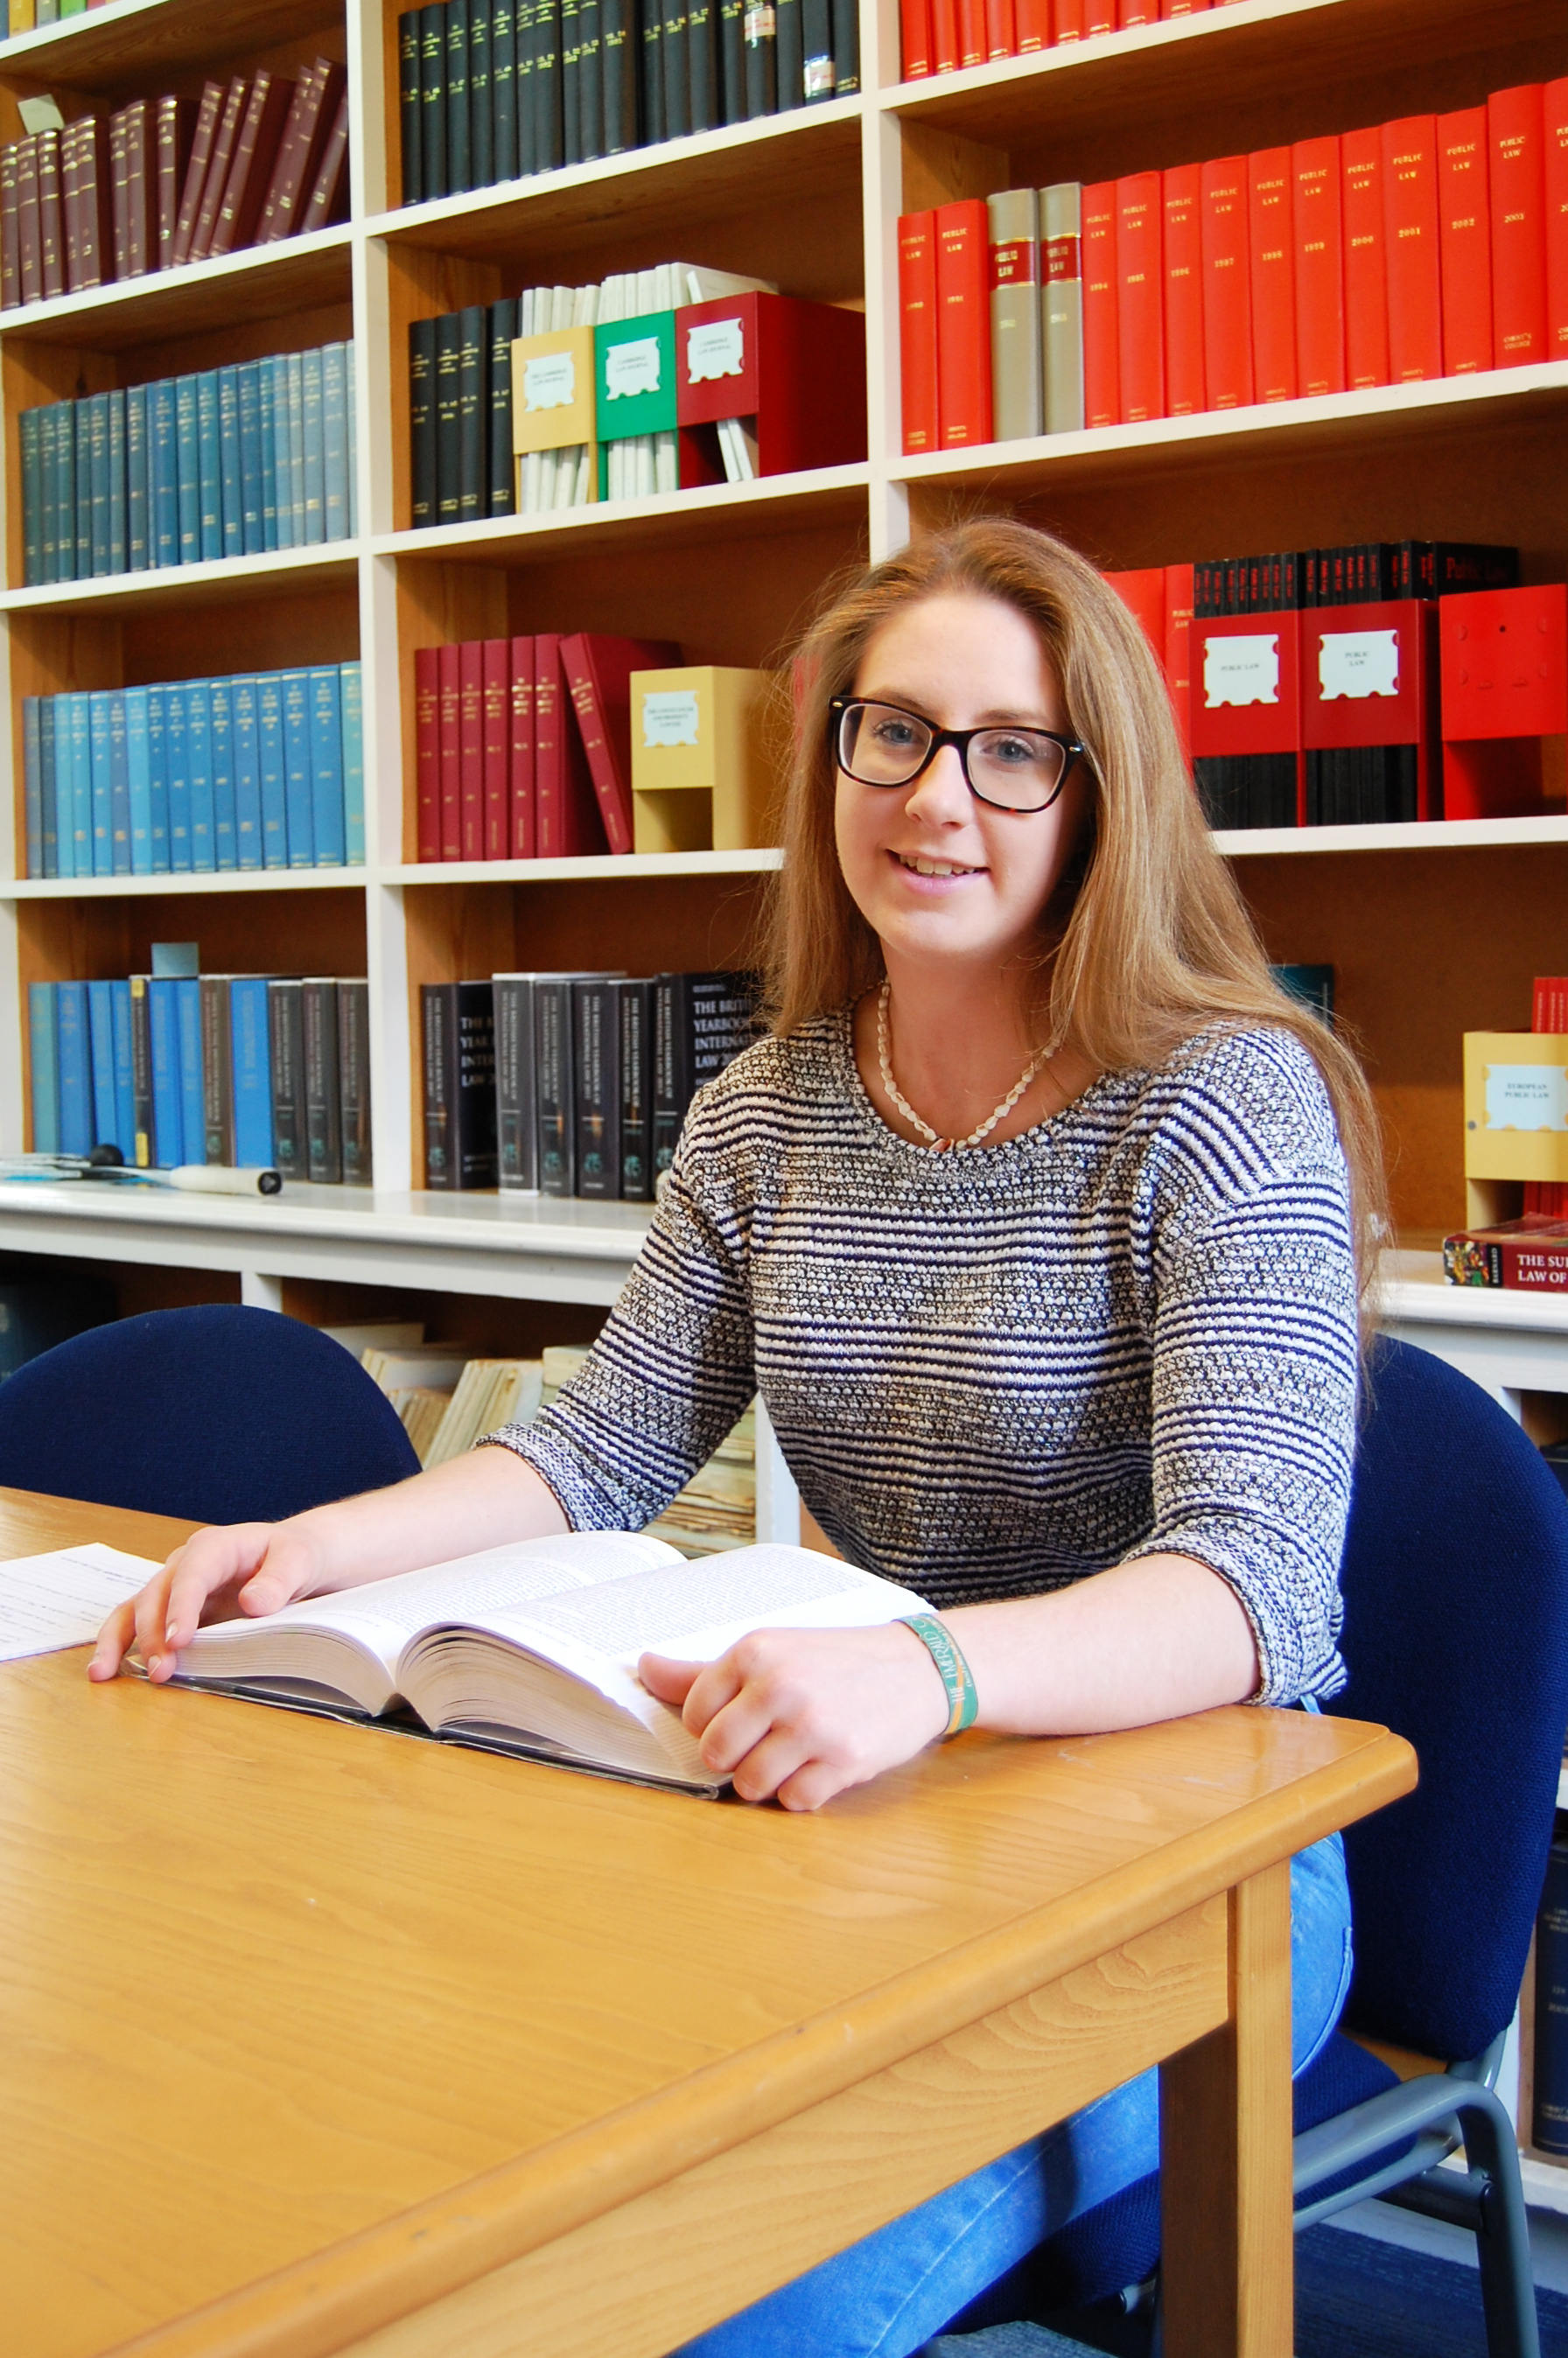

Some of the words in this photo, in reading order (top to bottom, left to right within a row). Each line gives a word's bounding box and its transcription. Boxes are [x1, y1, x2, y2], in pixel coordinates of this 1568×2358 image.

[1499, 136, 1526, 149] PUBLIC
[1446, 143, 1476, 156] PUBLIC
[1502, 149, 1522, 159] LAW
[1393, 153, 1423, 165] PUBLIC
[1348, 162, 1376, 174] PUBLIC
[1452, 161, 1471, 171] LAW
[1299, 169, 1328, 181] PUBLIC
[1398, 171, 1417, 180] LAW
[1256, 179, 1284, 191] PUBLIC
[1353, 180, 1370, 190] LAW
[1210, 188, 1238, 199] PUBLIC
[1305, 186, 1321, 196] LAW
[1166, 198, 1193, 208] PUBLIC
[1262, 196, 1279, 206] LAW
[1123, 204, 1147, 215] PUBLIC
[1215, 204, 1233, 213] LAW
[1087, 213, 1111, 224] PUBLIC
[1171, 214, 1187, 223] LAW
[1452, 217, 1475, 230] 2002
[1127, 220, 1142, 229] LAW
[942, 227, 968, 239] PUBLIC
[1090, 230, 1106, 239] LAW
[1398, 227, 1421, 239] 2001
[947, 243, 962, 253] LAW
[998, 265, 1013, 278] LAW
[1345, 650, 1370, 660] PUBLIC
[1221, 663, 1242, 672] PUBLIC
[1244, 662, 1260, 671] LAW
[1349, 659, 1366, 668] LAW
[693, 1000, 718, 1015] THE
[695, 1054, 719, 1069] LAW
[1516, 1254, 1545, 1268] THE
[1517, 1270, 1548, 1283] LAW
[1548, 1272, 1567, 1284] OF
[923, 1631, 959, 1679] EMERALD
[949, 1686, 966, 1703] THE
